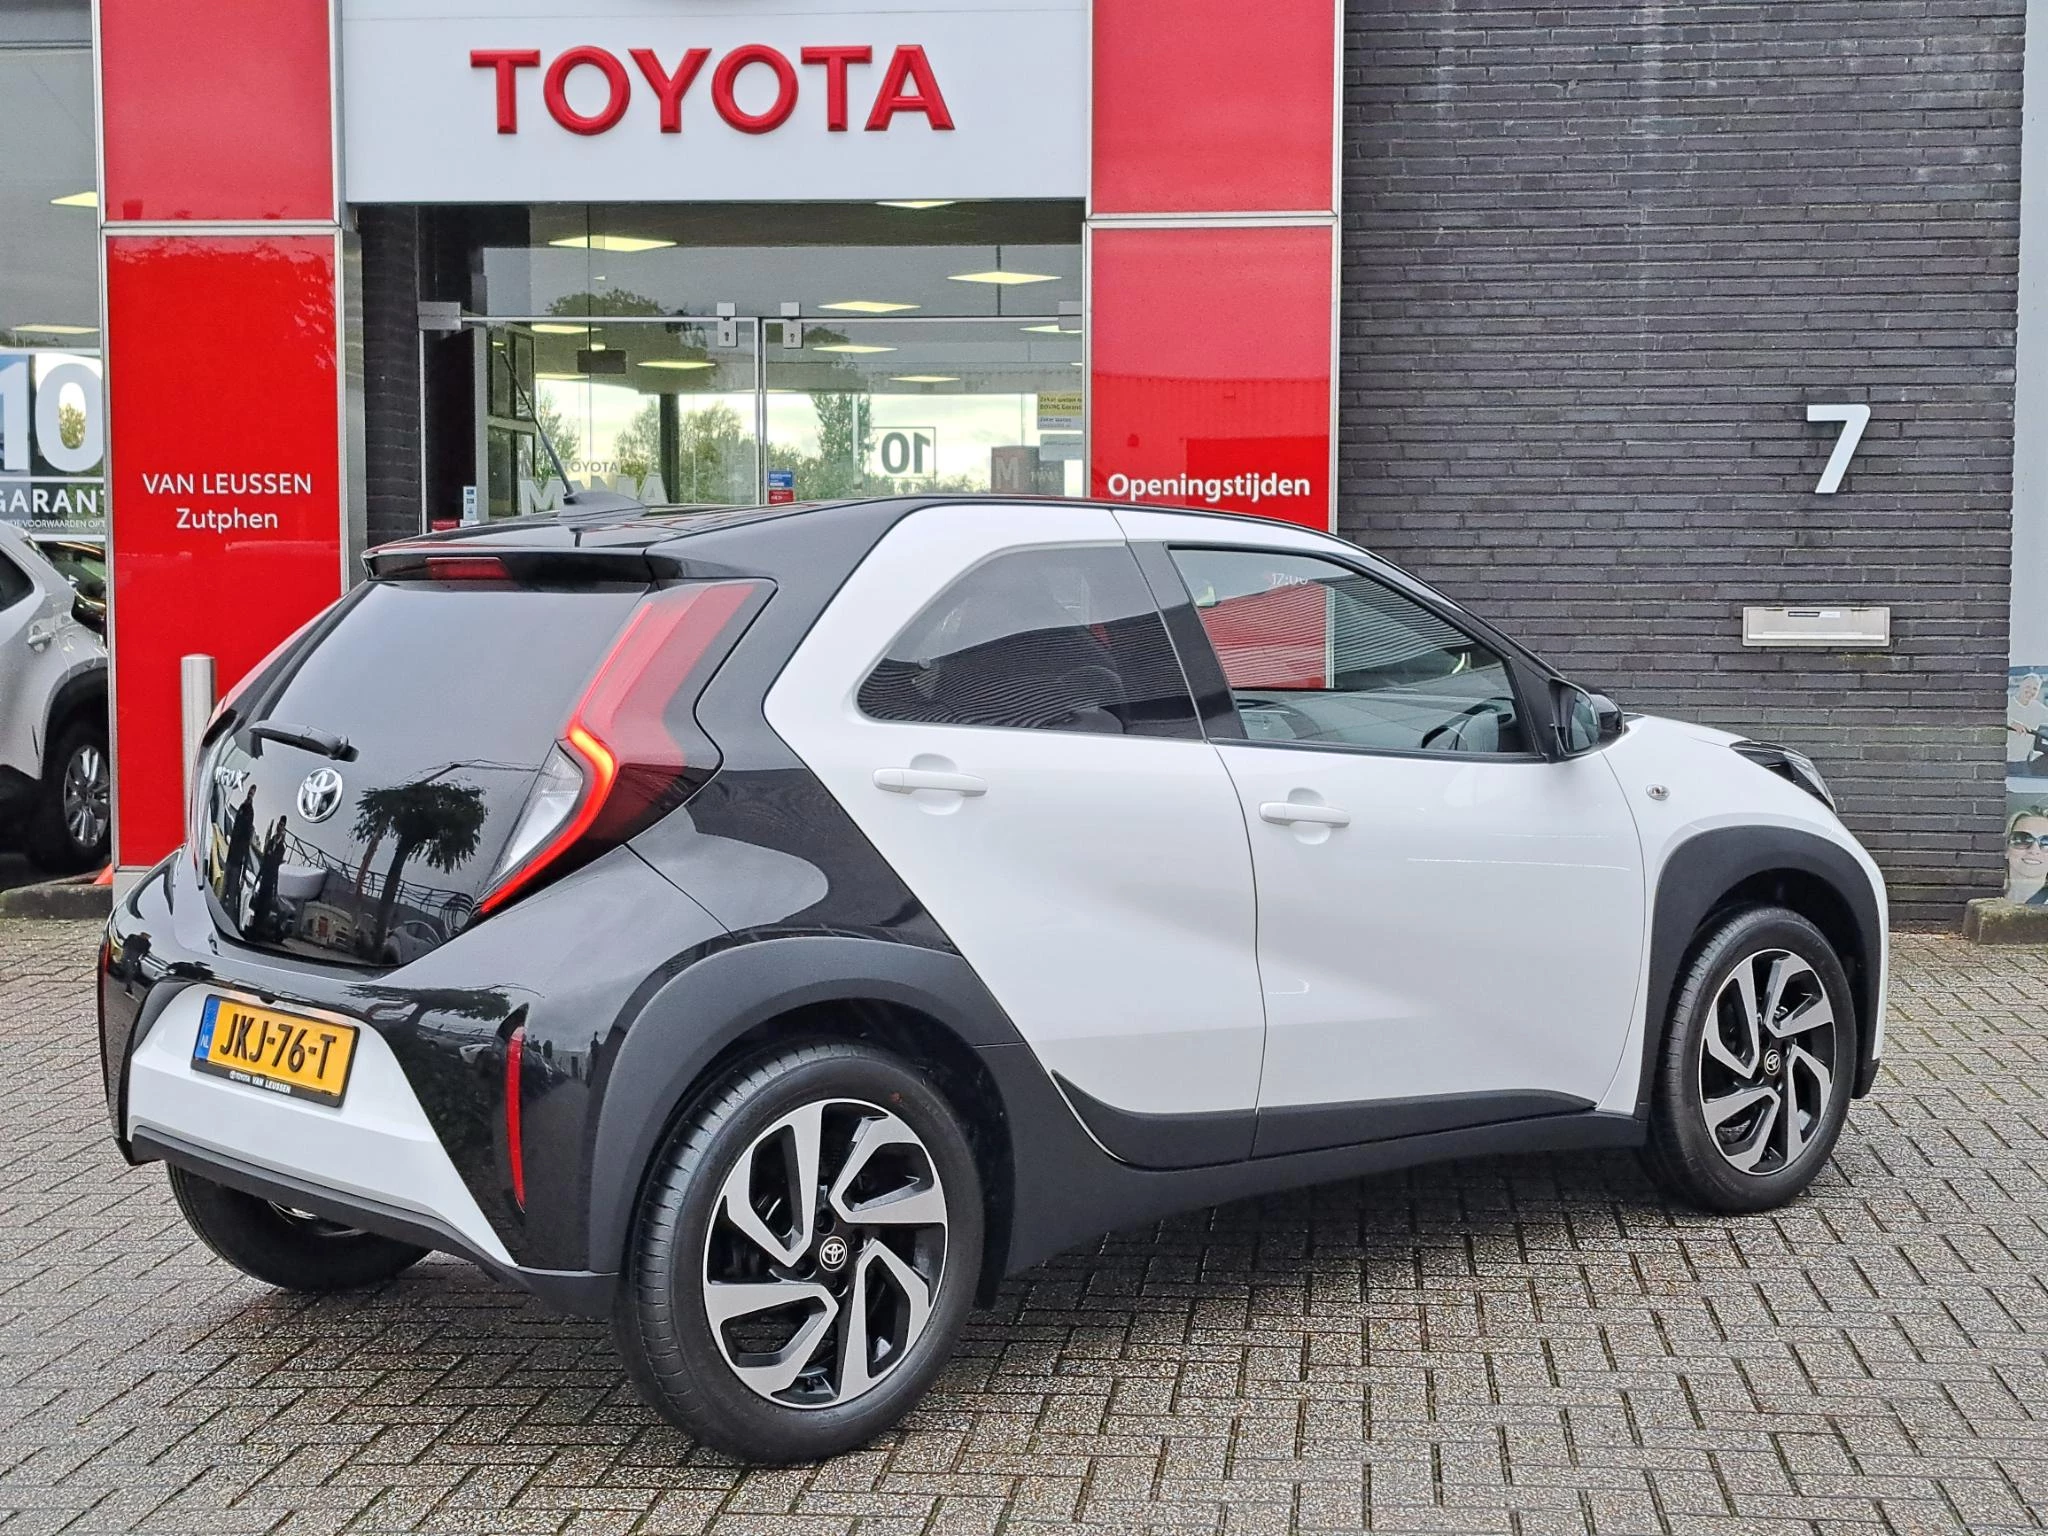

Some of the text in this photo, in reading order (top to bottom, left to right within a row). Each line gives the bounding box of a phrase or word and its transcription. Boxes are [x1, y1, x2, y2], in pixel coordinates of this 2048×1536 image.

[470, 44, 955, 135] TOYOTA
[0, 360, 104, 472] 10
[1806, 404, 1871, 494] 7
[563, 461, 619, 473] TOYOTA
[142, 473, 312, 495] VAN LEUSSEN
[1107, 472, 1311, 503] Openingstijden
[0, 488, 104, 514] ARAN
[23, 519, 86, 528] VOORWAARDEN
[176, 507, 278, 534] Zutphen
[200, 1034, 209, 1048] NL
[220, 1013, 337, 1079] JKJ-76-T
[252, 1076, 264, 1087] VAN
[265, 1079, 291, 1094] LEUSSEN
